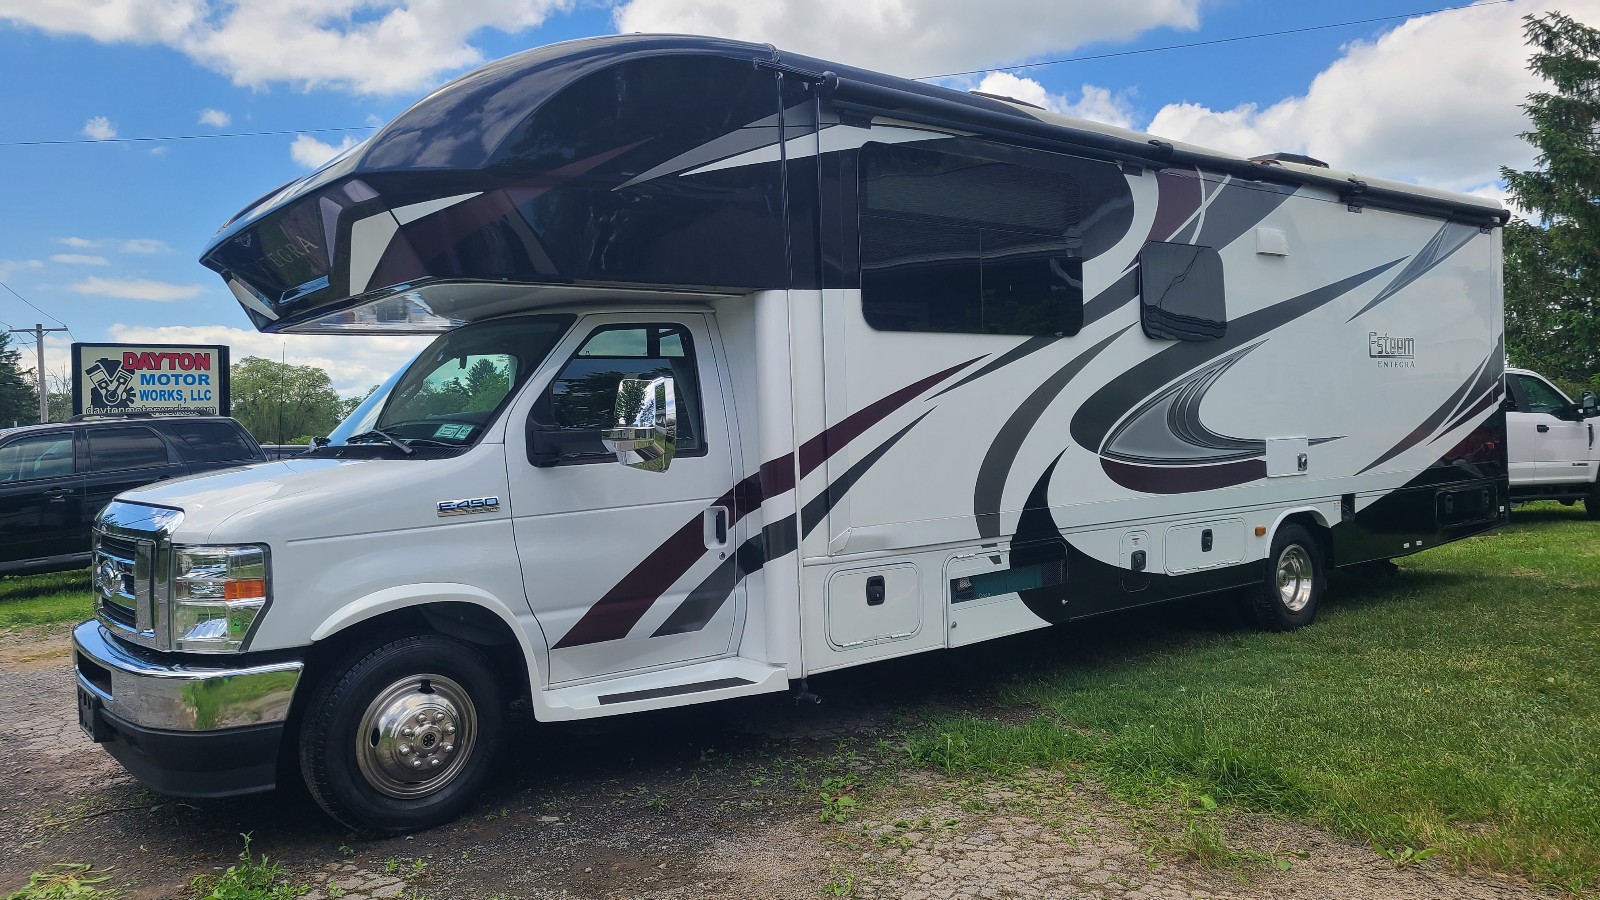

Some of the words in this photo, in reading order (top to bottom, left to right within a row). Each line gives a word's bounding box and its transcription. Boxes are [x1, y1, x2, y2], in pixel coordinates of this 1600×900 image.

[1369, 331, 1415, 359] Esteem
[123, 352, 211, 371] DAYTON
[1377, 360, 1416, 368] ENTEGRA
[140, 373, 211, 386] MOTOR
[139, 389, 187, 404] WORKS,
[190, 389, 212, 402] LLC
[438, 497, 500, 511] E-450
